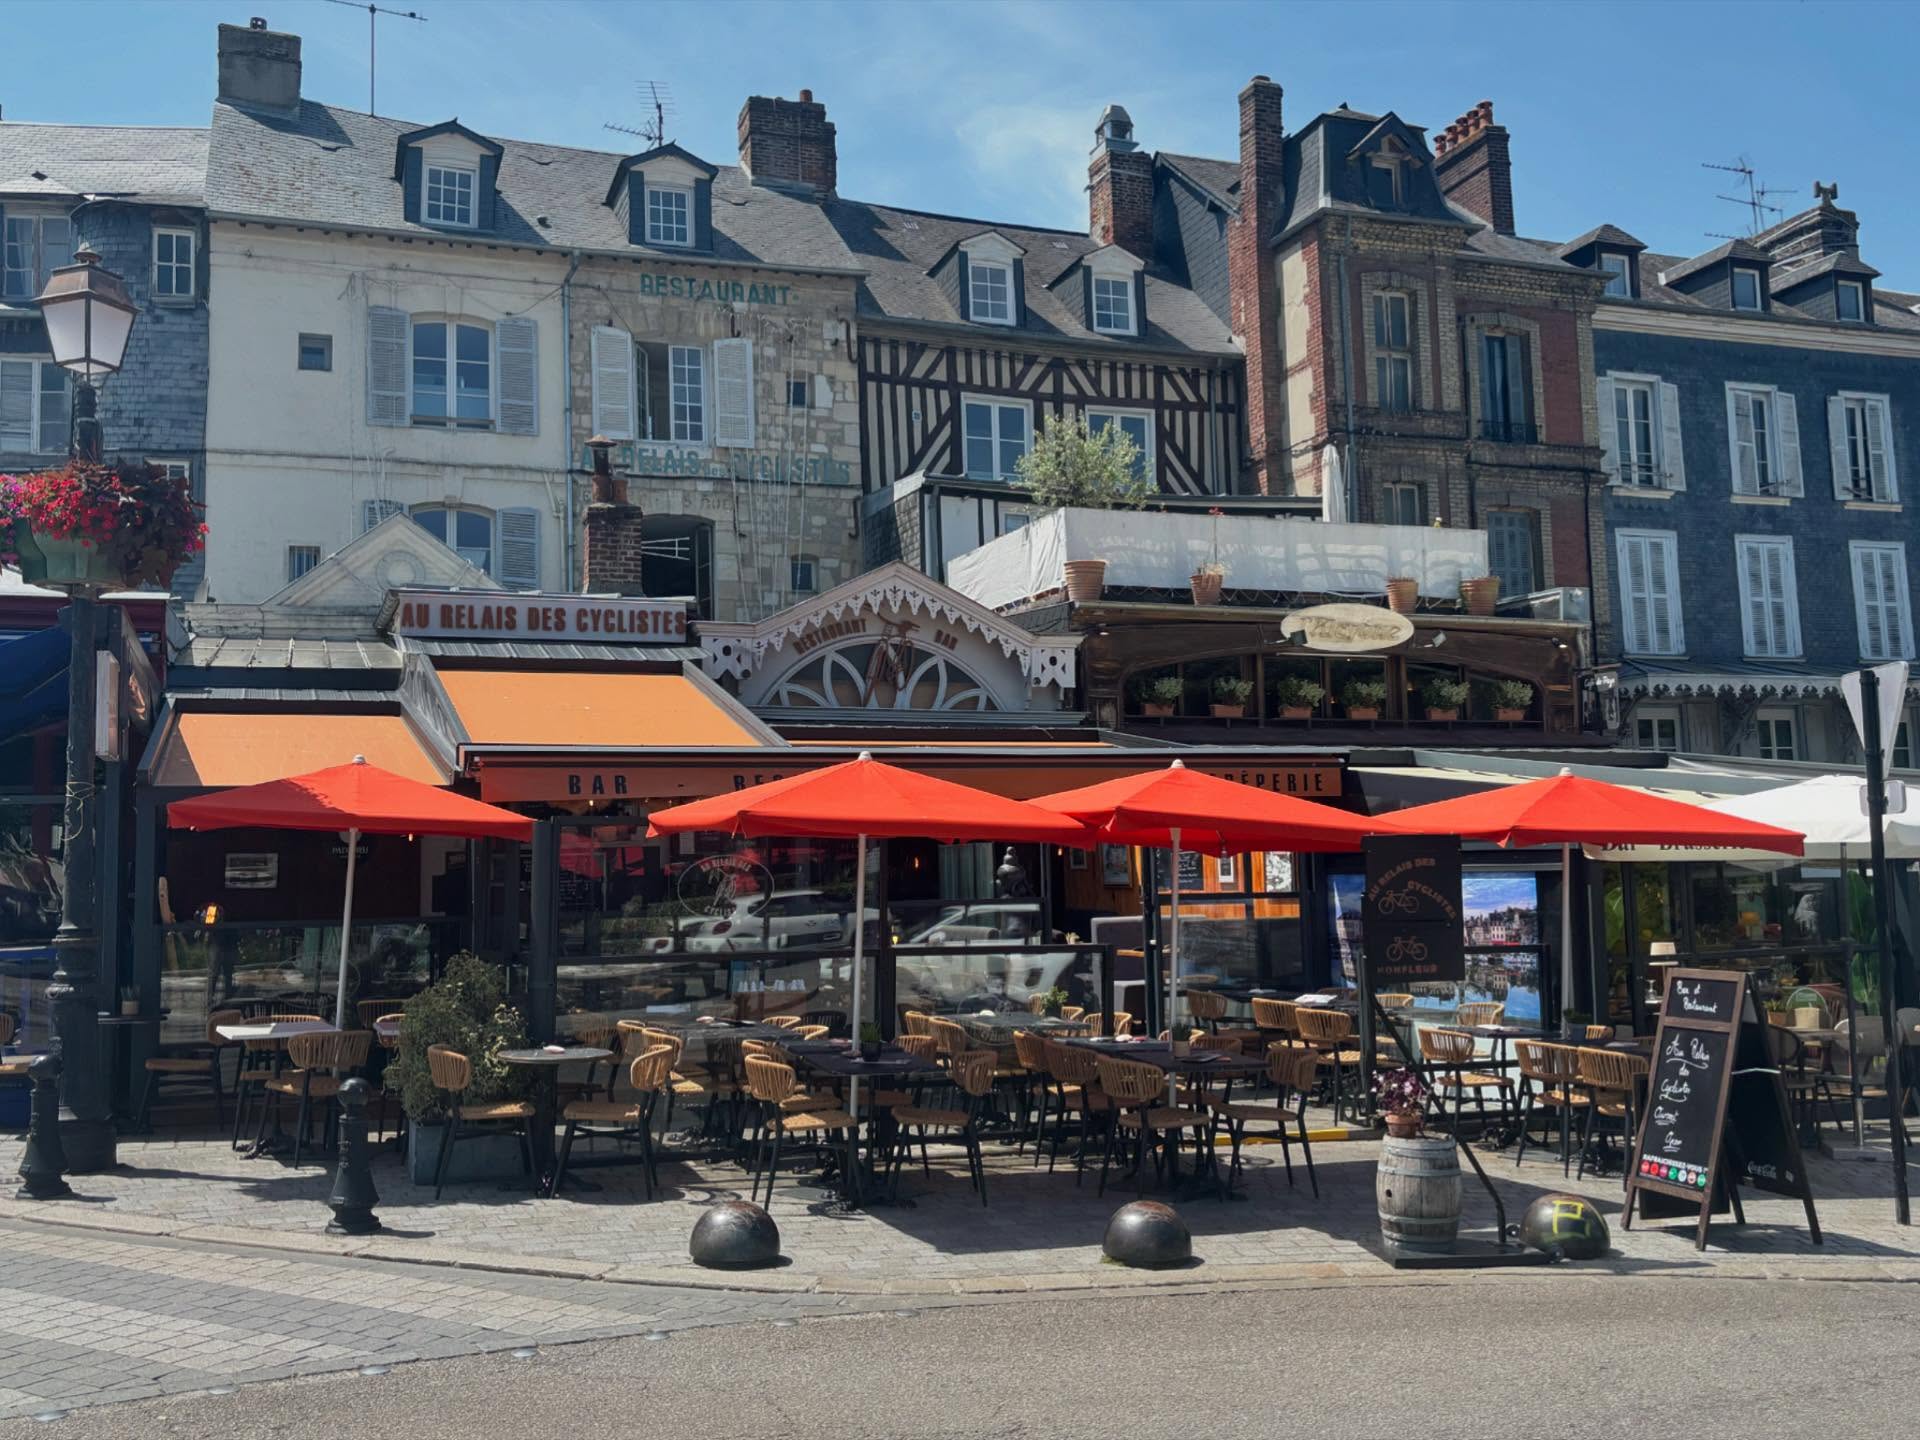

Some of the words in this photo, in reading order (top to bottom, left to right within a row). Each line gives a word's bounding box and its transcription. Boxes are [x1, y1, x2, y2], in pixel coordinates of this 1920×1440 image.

[640, 273, 791, 305] RESTAURANT
[401, 602, 430, 629] AU
[440, 604, 518, 631] RELAIS
[527, 606, 567, 632] DES
[576, 607, 687, 635] CYCLISTES
[793, 618, 867, 656] RESTAURANT
[934, 629, 959, 651] BAR
[568, 774, 628, 795] BAR
[1210, 770, 1322, 791] ÊPERIE
